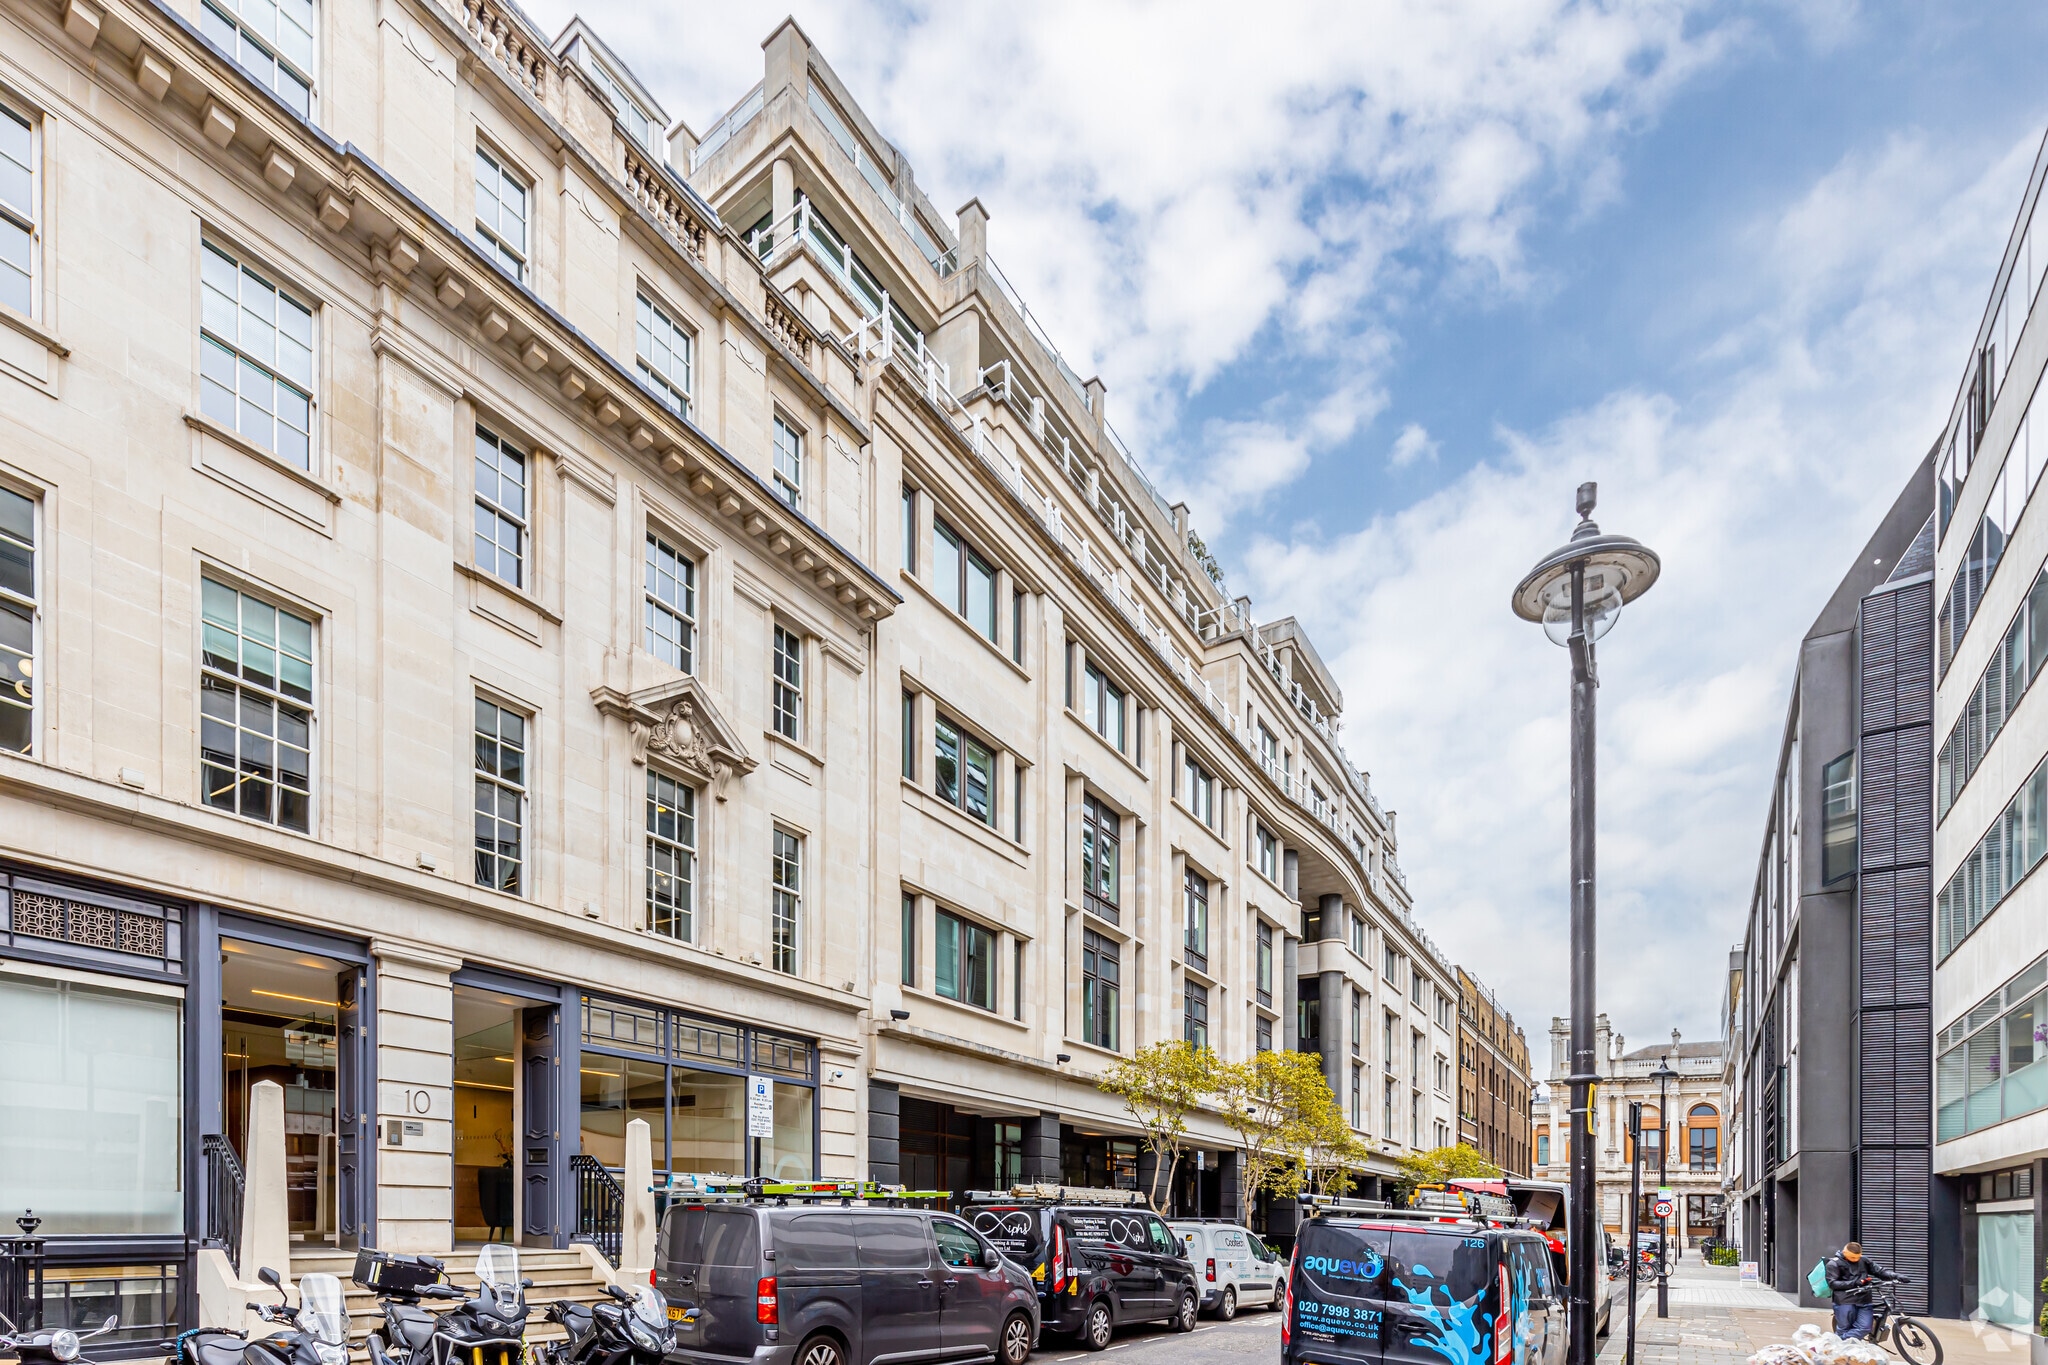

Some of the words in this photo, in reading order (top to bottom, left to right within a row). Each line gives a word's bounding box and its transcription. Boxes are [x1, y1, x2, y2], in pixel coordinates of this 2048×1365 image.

[405, 1089, 431, 1114] 10
[1463, 1238, 1485, 1249] 126
[1304, 1255, 1380, 1278] aquevo
[1299, 1301, 1319, 1313] 020
[1321, 1304, 1350, 1318] 7998
[1353, 1309, 1383, 1323] 3871
[1300, 1313, 1379, 1331] www.aquevo.co.uk
[1300, 1321, 1379, 1339] office@aquevo.co.uk
